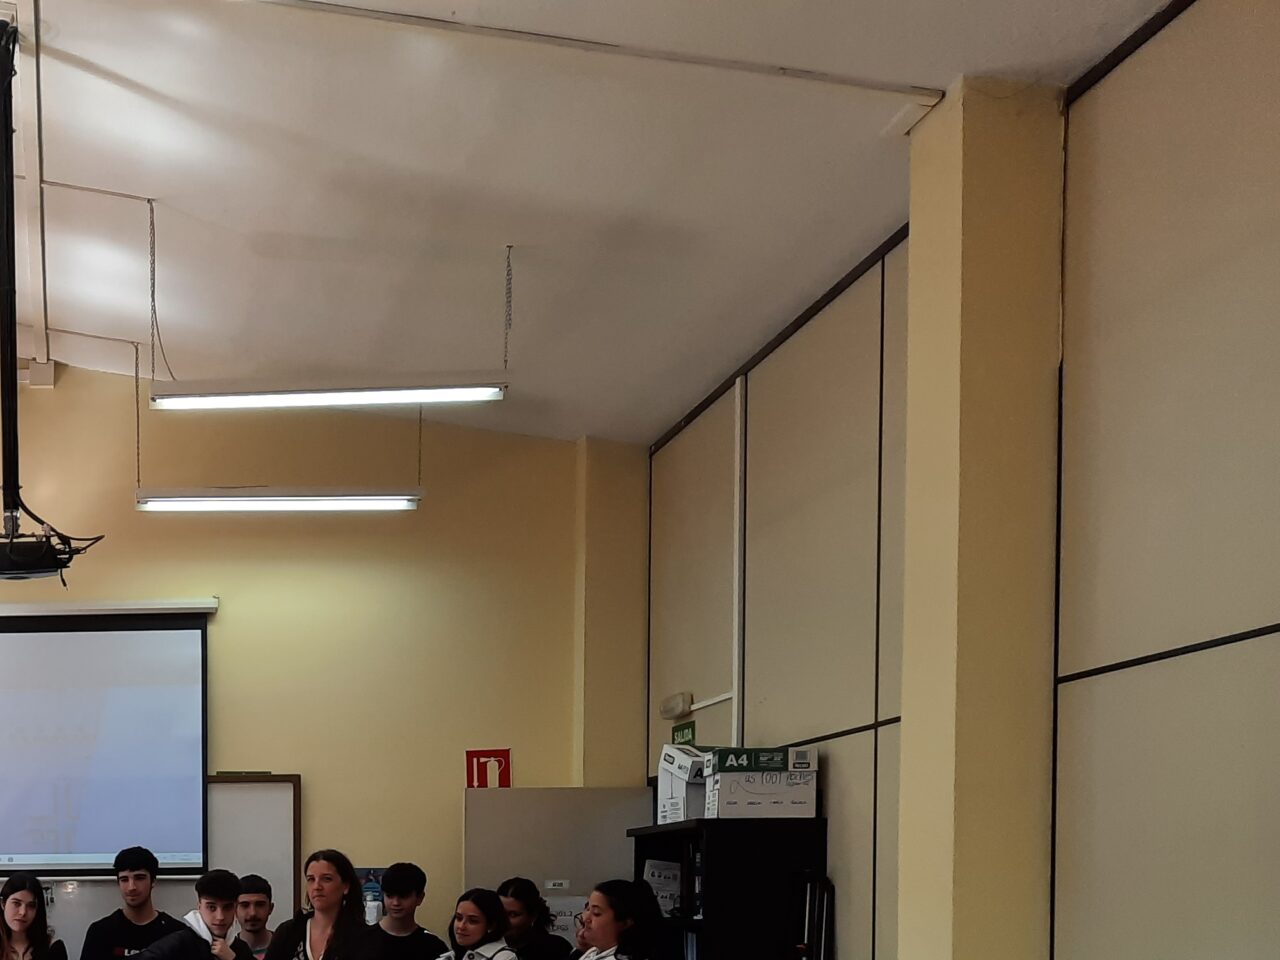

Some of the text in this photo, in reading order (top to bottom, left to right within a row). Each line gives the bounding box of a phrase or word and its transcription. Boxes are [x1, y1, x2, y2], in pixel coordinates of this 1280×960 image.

[674, 728, 692, 744] SALIDA
[725, 753, 749, 767] A4
[693, 767, 704, 779] A
